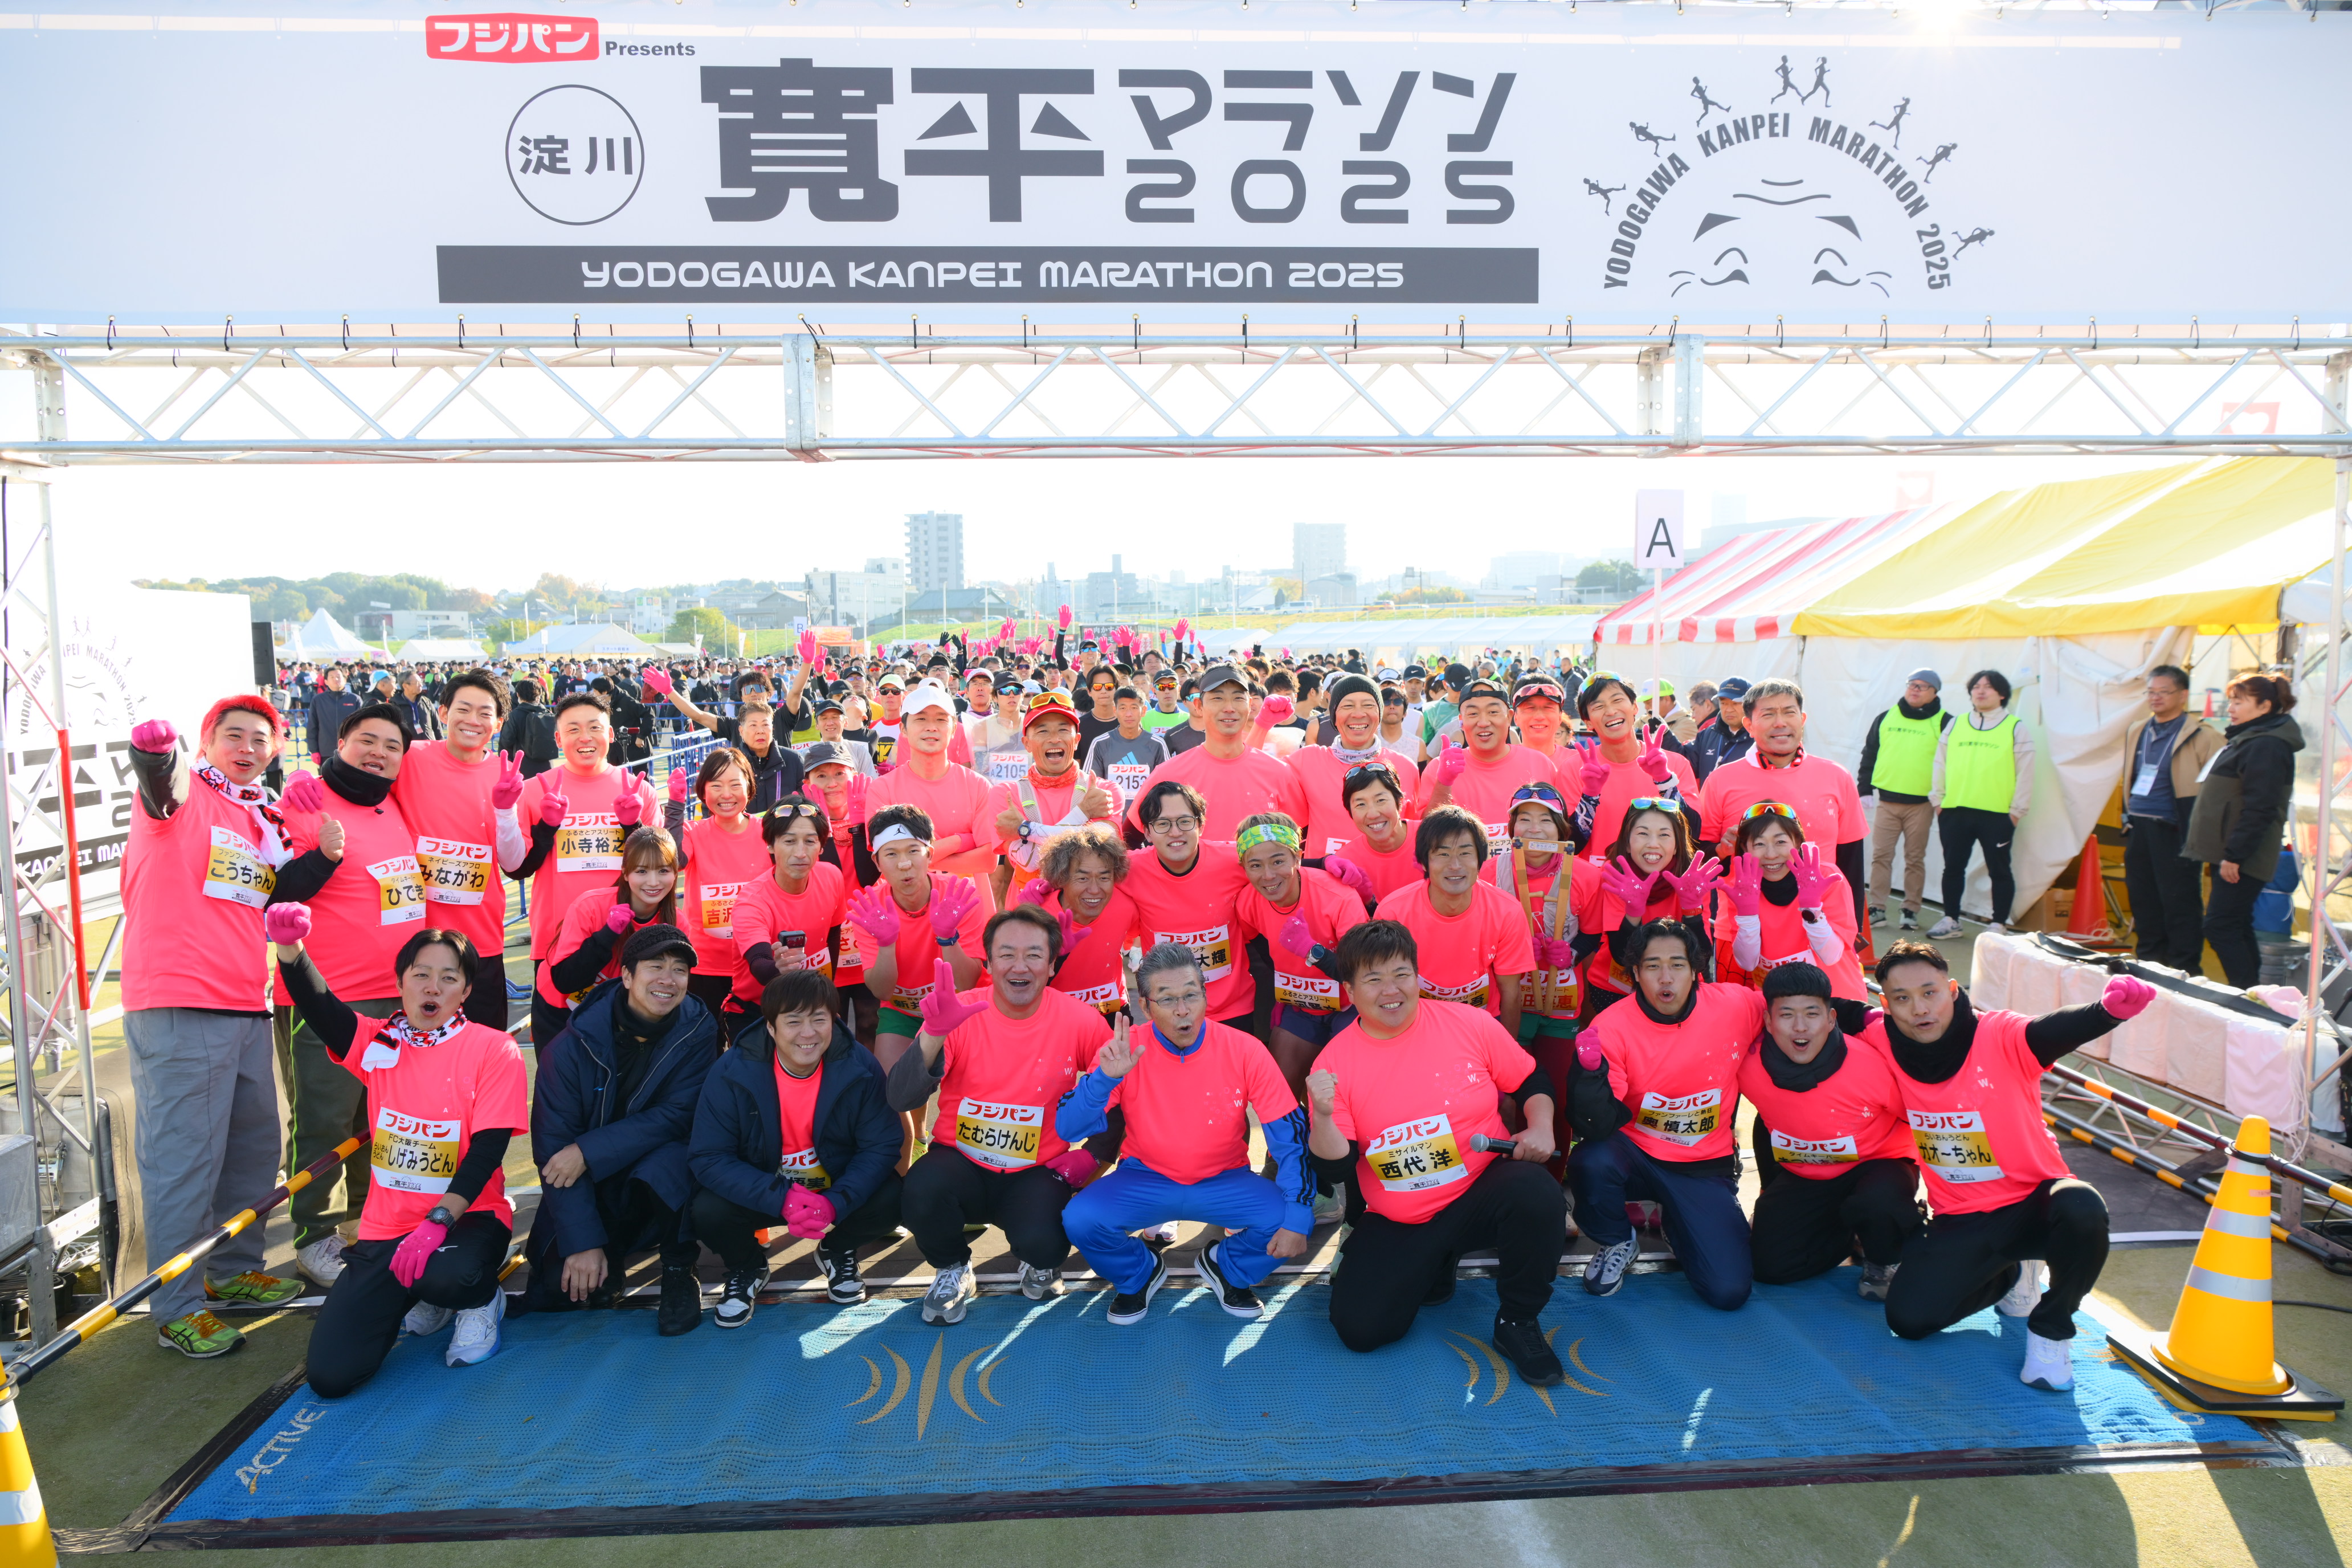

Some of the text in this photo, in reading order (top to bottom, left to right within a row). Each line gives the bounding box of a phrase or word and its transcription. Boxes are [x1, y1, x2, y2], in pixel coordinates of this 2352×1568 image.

[431, 21, 696, 57] フジパン Presents
[1118, 69, 1517, 153] マラソン
[518, 135, 633, 176] 淀川
[1125, 159, 1515, 224] 2025
[1604, 112, 1951, 291] YODOGAWA KANPEI MARATHON 2025
[581, 261, 1404, 288] YODOGAWA KANPEI MARATHON 2025
[1645, 518, 1676, 558] A
[86, 645, 126, 692] MARATHON
[564, 815, 620, 827] フジパン
[218, 831, 260, 860] フジパン
[426, 840, 487, 859] フジパン
[374, 859, 415, 875] フジパン
[428, 857, 480, 869] ネイビーズアフロ
[211, 859, 274, 891] こうちゃん
[419, 864, 484, 888] みながわ
[386, 884, 424, 906] ひでき
[1161, 930, 1222, 945] フジパン
[1279, 974, 1332, 994] フジパン
[1423, 980, 1483, 996] フジパン
[1283, 990, 1330, 1003] ふるさとアスリート
[967, 1101, 1035, 1122] フジパン
[1651, 1093, 1714, 1110] フジパン
[385, 1112, 451, 1138] フジパン
[1913, 1113, 1974, 1129] フジパン
[388, 1133, 436, 1150] FC大阪チーム
[958, 1121, 1035, 1153] たむらけんじ
[1374, 1121, 1440, 1150] フジパン
[1777, 1134, 1847, 1153] フジパン
[1924, 1133, 1970, 1141] らいおんうどん
[387, 1145, 454, 1173] しげみうどん
[1388, 1142, 1432, 1158] ミサイルマン
[235, 1407, 328, 1493] ACTIVE
